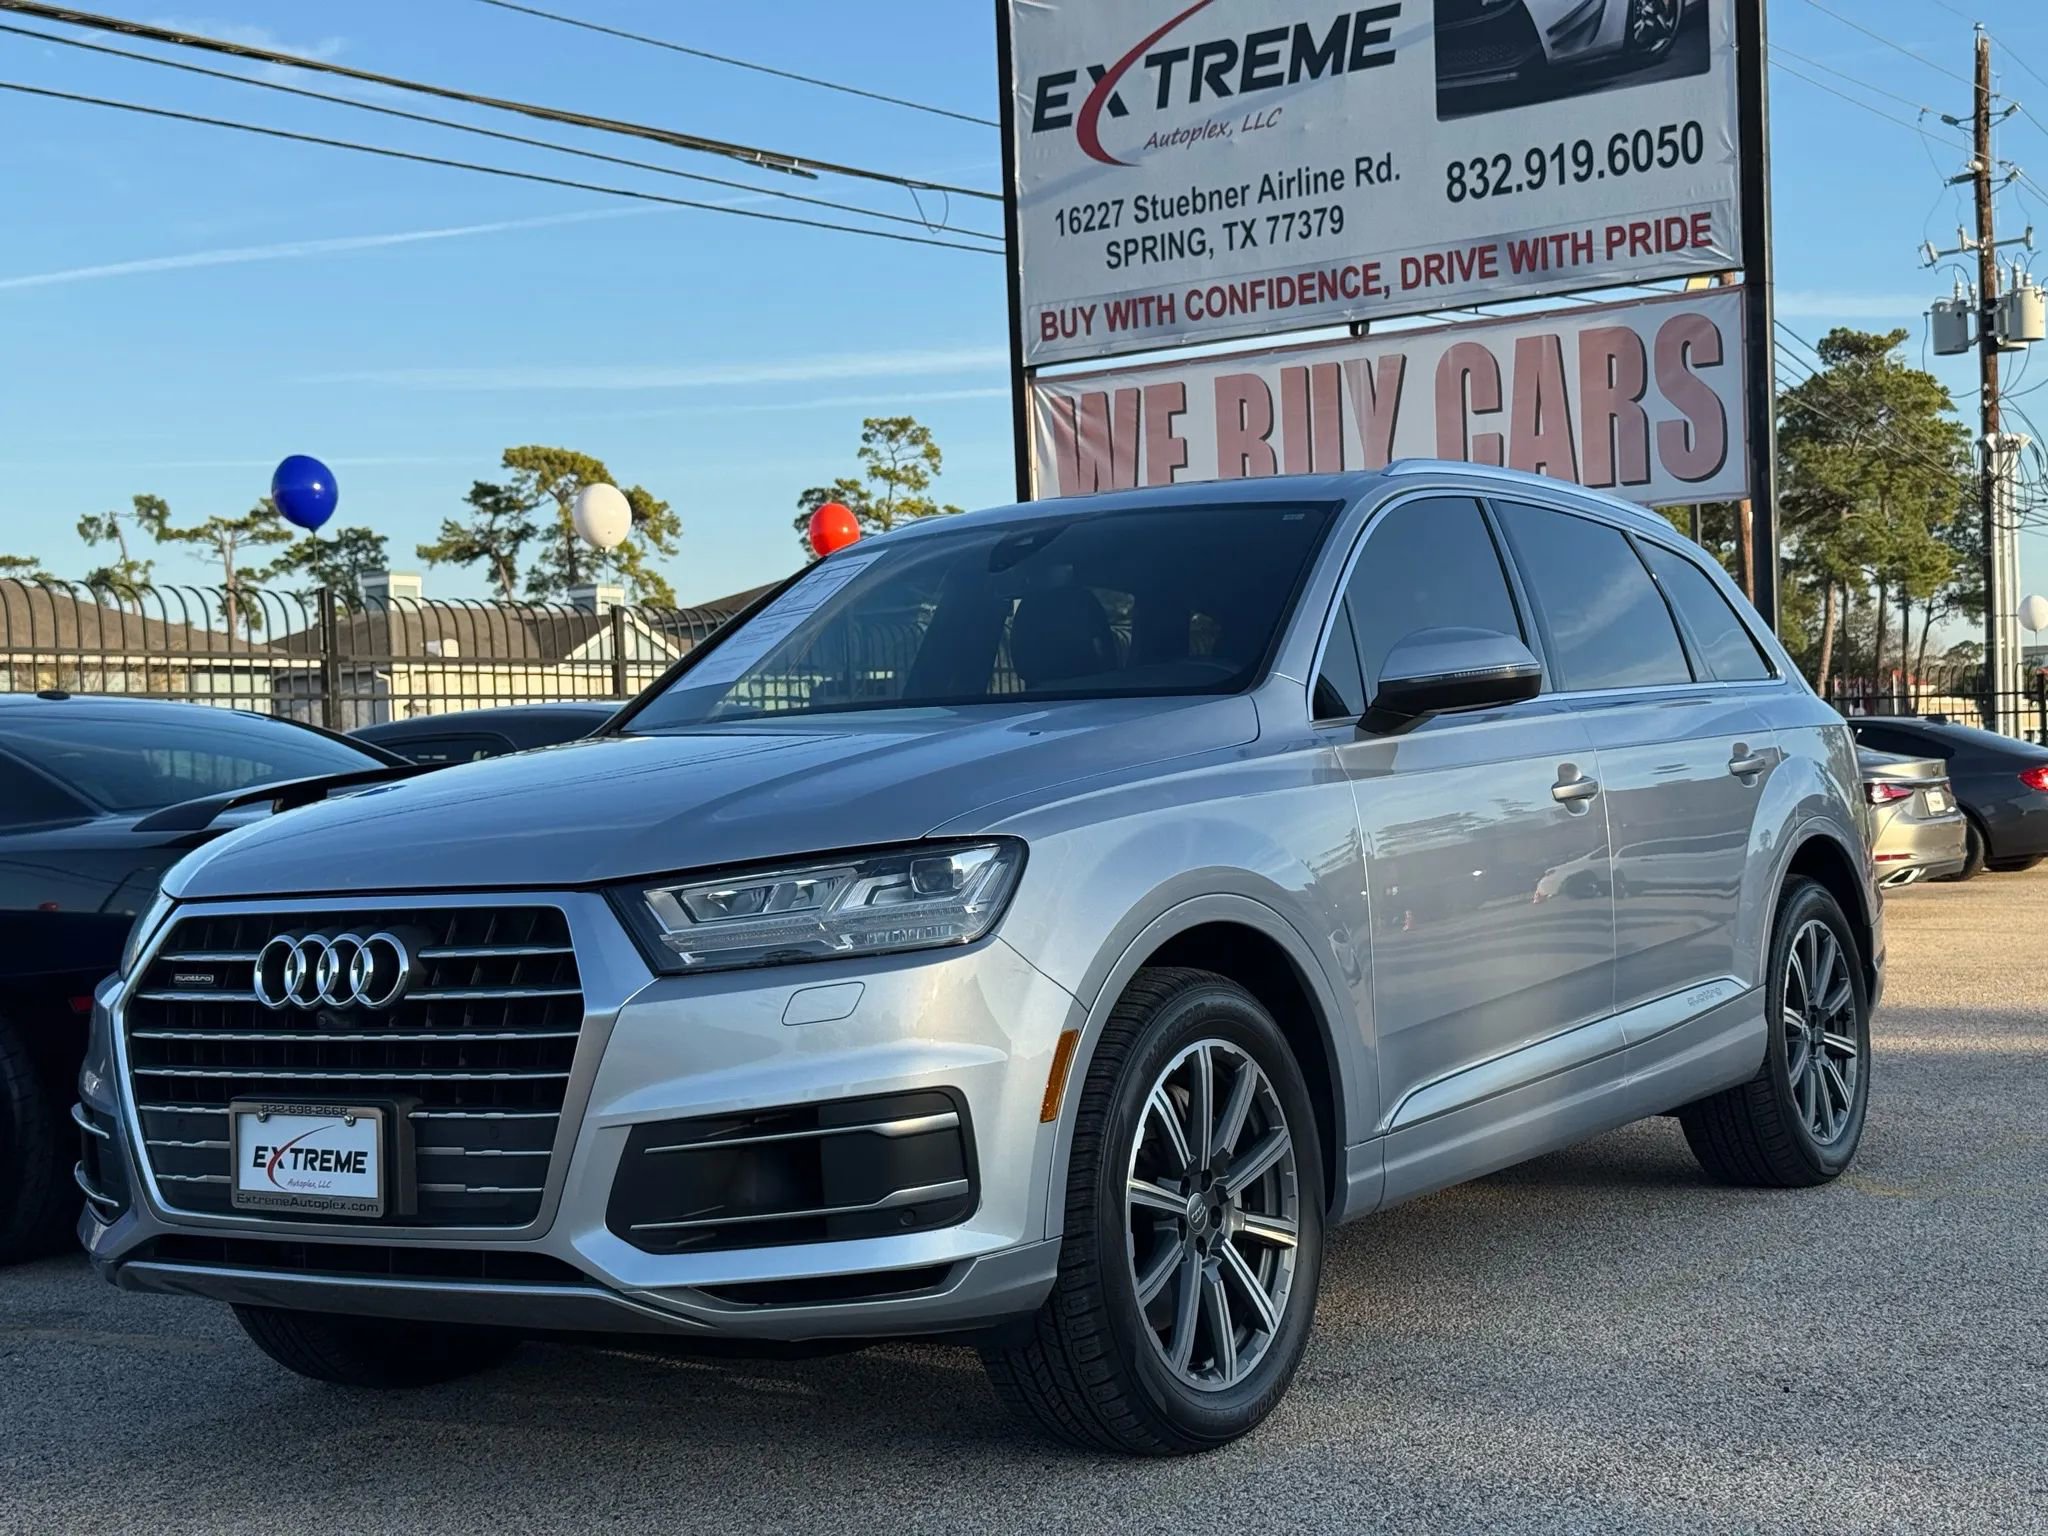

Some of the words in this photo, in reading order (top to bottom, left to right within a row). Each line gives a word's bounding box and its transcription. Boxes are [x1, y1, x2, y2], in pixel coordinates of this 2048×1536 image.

[1031, 4, 1399, 134] EXTREME
[1143, 119, 1234, 150] Autoplex,
[1241, 107, 1283, 132] LLC
[1446, 120, 1704, 204] 832.919.6050
[1054, 199, 1125, 237] 16227
[1133, 184, 1251, 224] Stuebner
[1257, 167, 1346, 204] Airline
[1355, 152, 1401, 187] Rd.
[1040, 304, 1098, 342] BUY
[1103, 292, 1176, 333] WITH
[1184, 262, 1391, 322] CONFIDENCE,
[1400, 244, 1499, 291] DRIVE
[1507, 229, 1595, 275] WITH
[1605, 212, 1714, 261] PRIDE
[1105, 227, 1215, 270] SPRING,
[1222, 219, 1259, 252] TX
[1266, 204, 1345, 246] 77379
[1050, 381, 1189, 496] WE
[1213, 354, 1408, 480] BUY
[1434, 312, 1729, 488] CARS
[252, 1145, 369, 1175] EXTREME
[236, 1193, 379, 1213] ExtremeAutoplex.com
